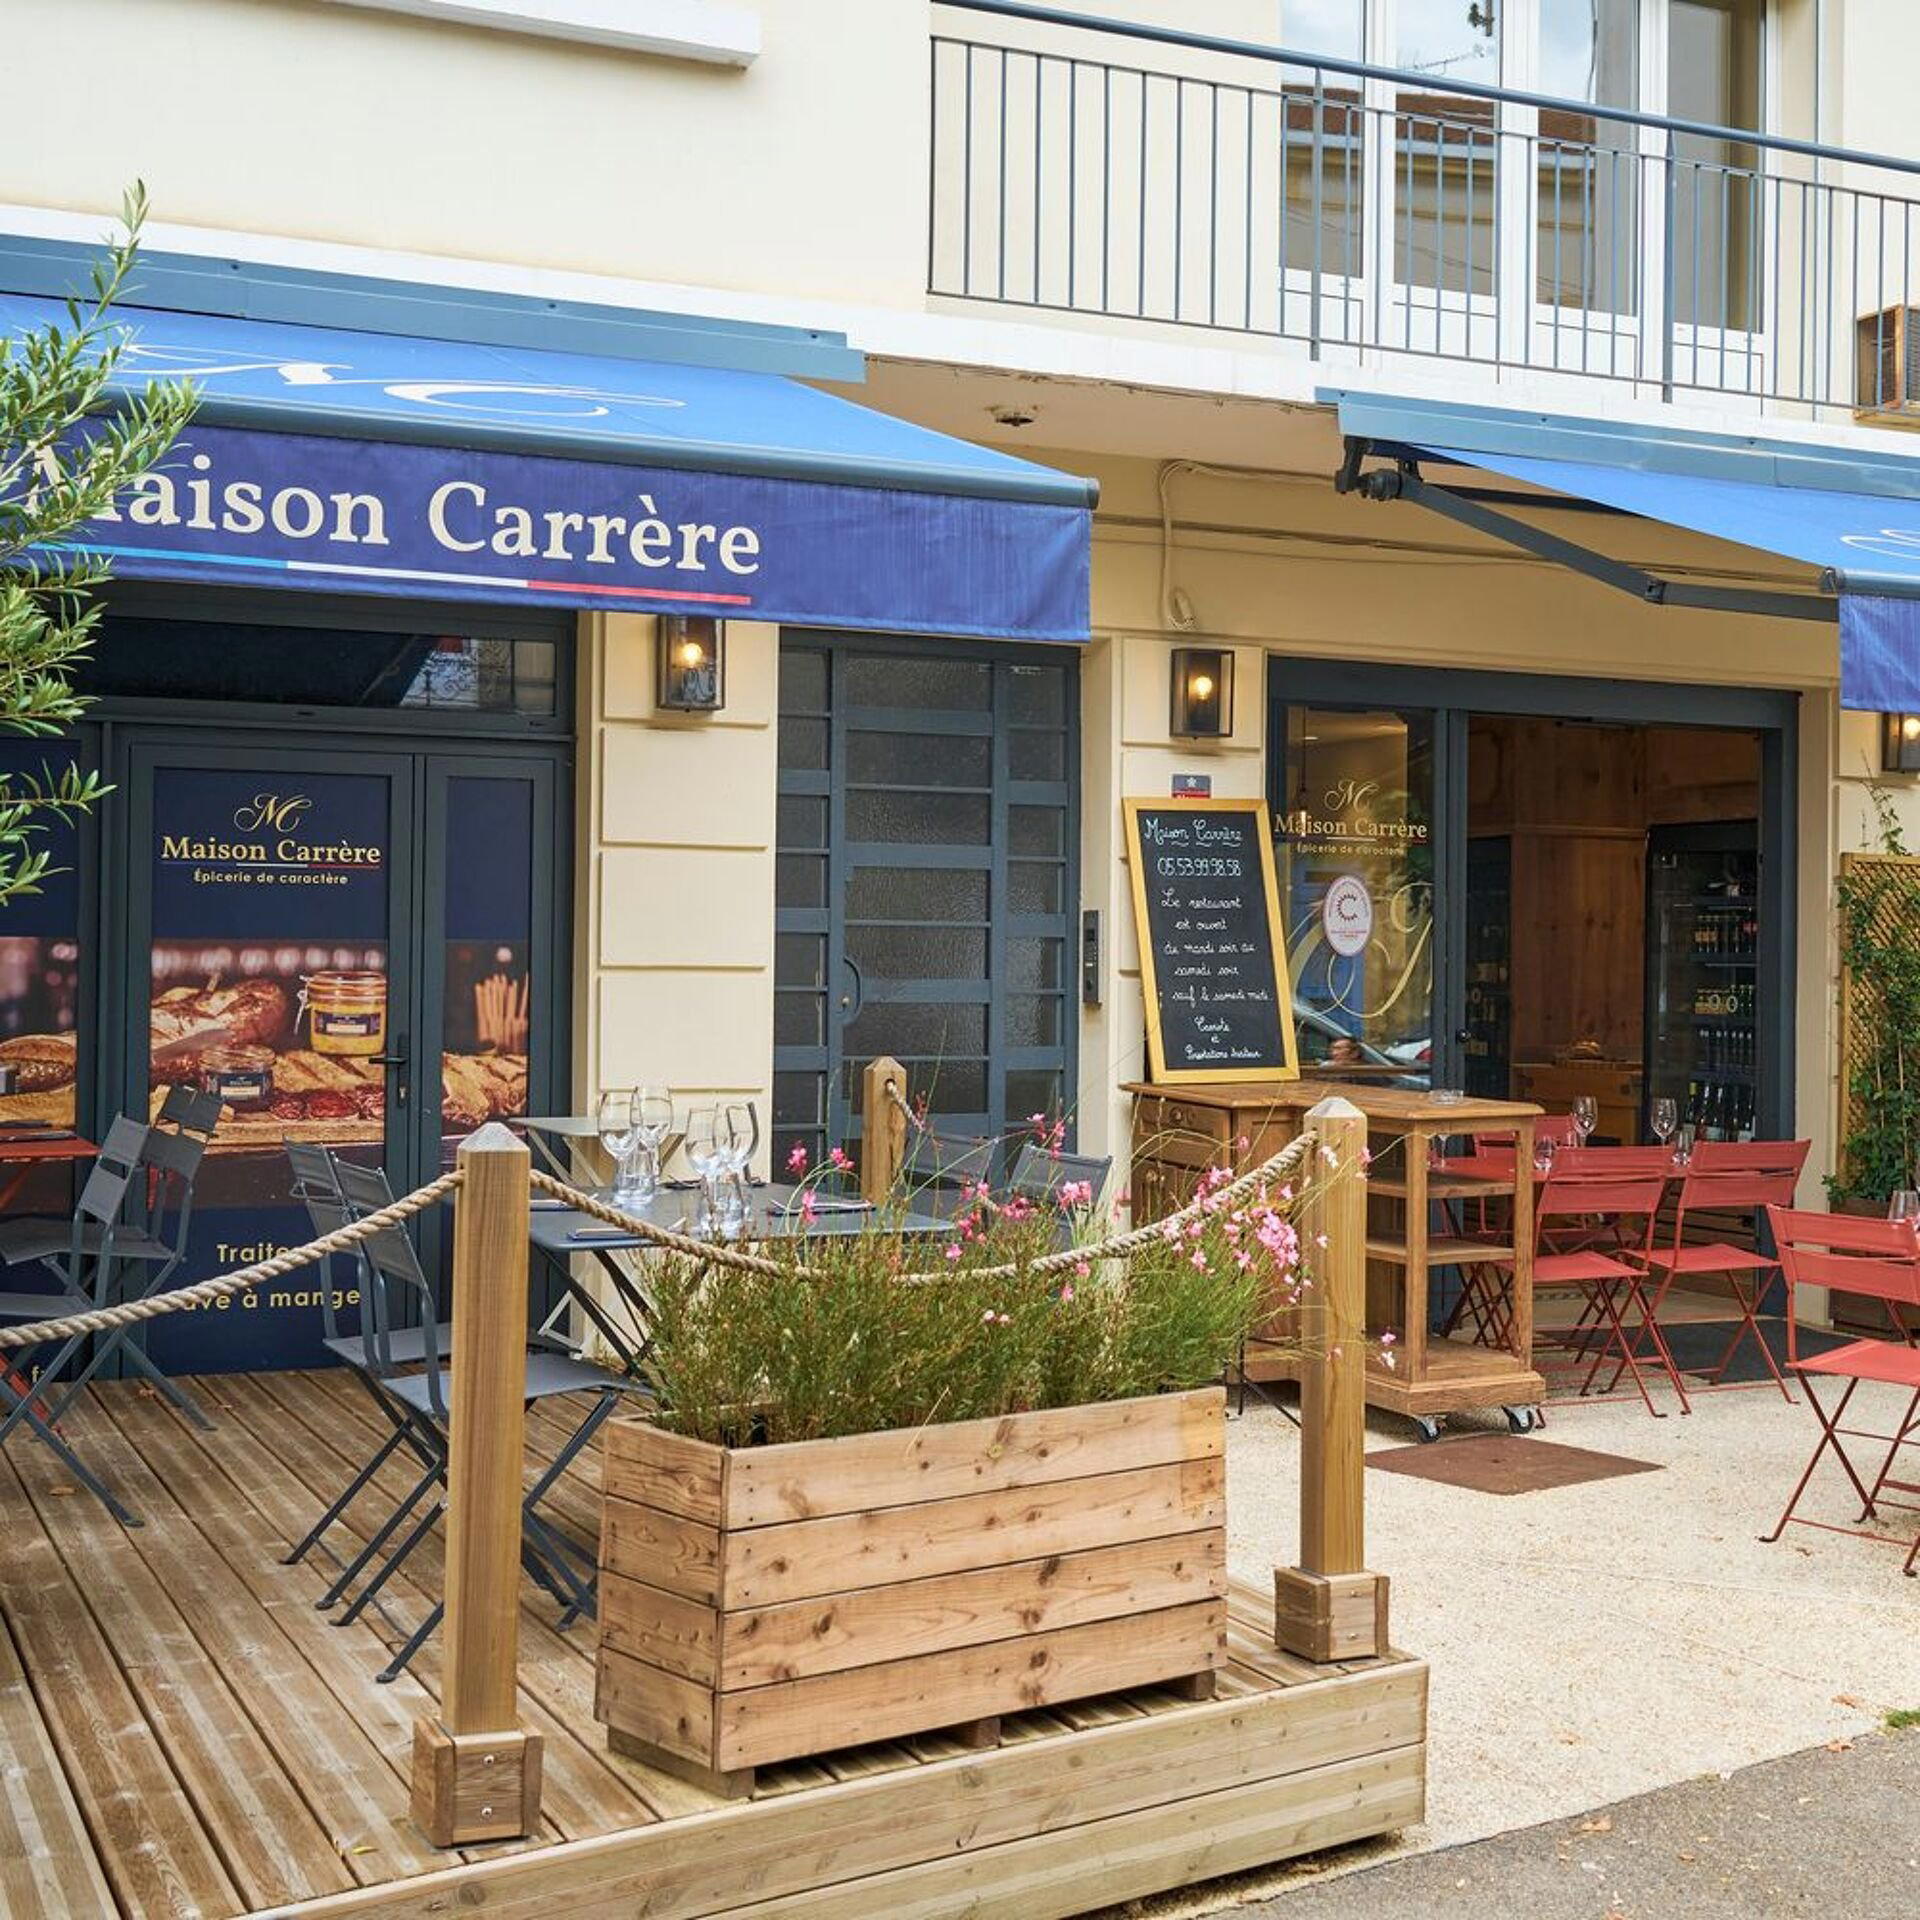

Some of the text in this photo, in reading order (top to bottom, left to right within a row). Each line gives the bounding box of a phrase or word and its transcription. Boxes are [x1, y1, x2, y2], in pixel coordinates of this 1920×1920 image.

[428, 480, 760, 574] Carrère
[1144, 818, 1189, 845] Maison
[1274, 814, 1428, 838] Maison Carrère
[162, 836, 381, 863] Maison Carrère
[194, 867, 348, 885] Épicerie de caractère
[243, 1287, 258, 1309] à
